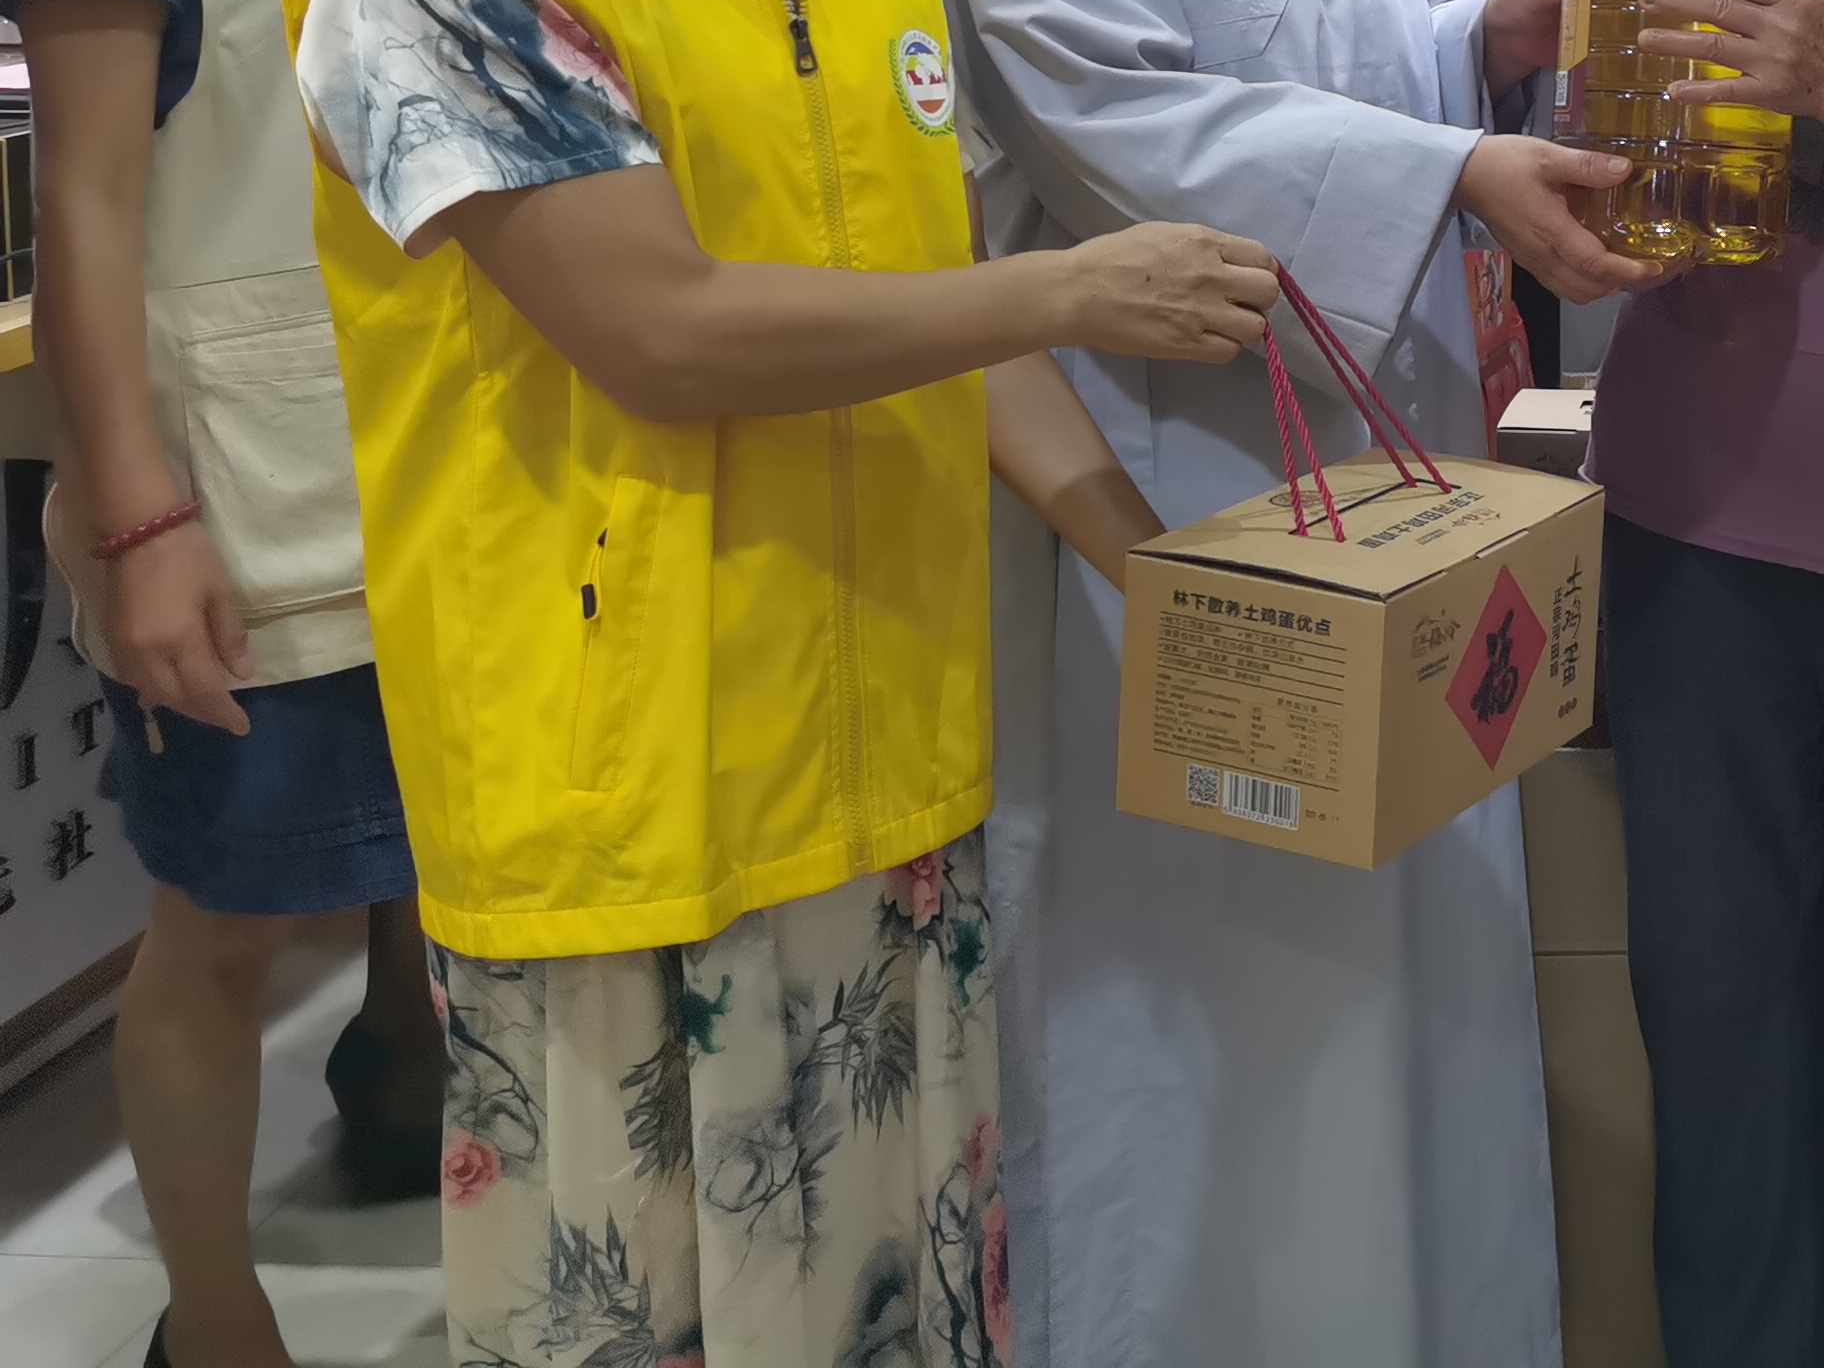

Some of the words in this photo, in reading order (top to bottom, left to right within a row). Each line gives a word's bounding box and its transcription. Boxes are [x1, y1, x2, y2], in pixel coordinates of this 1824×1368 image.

[1172, 589, 1333, 637] 林下散养土鸡蛋优点
